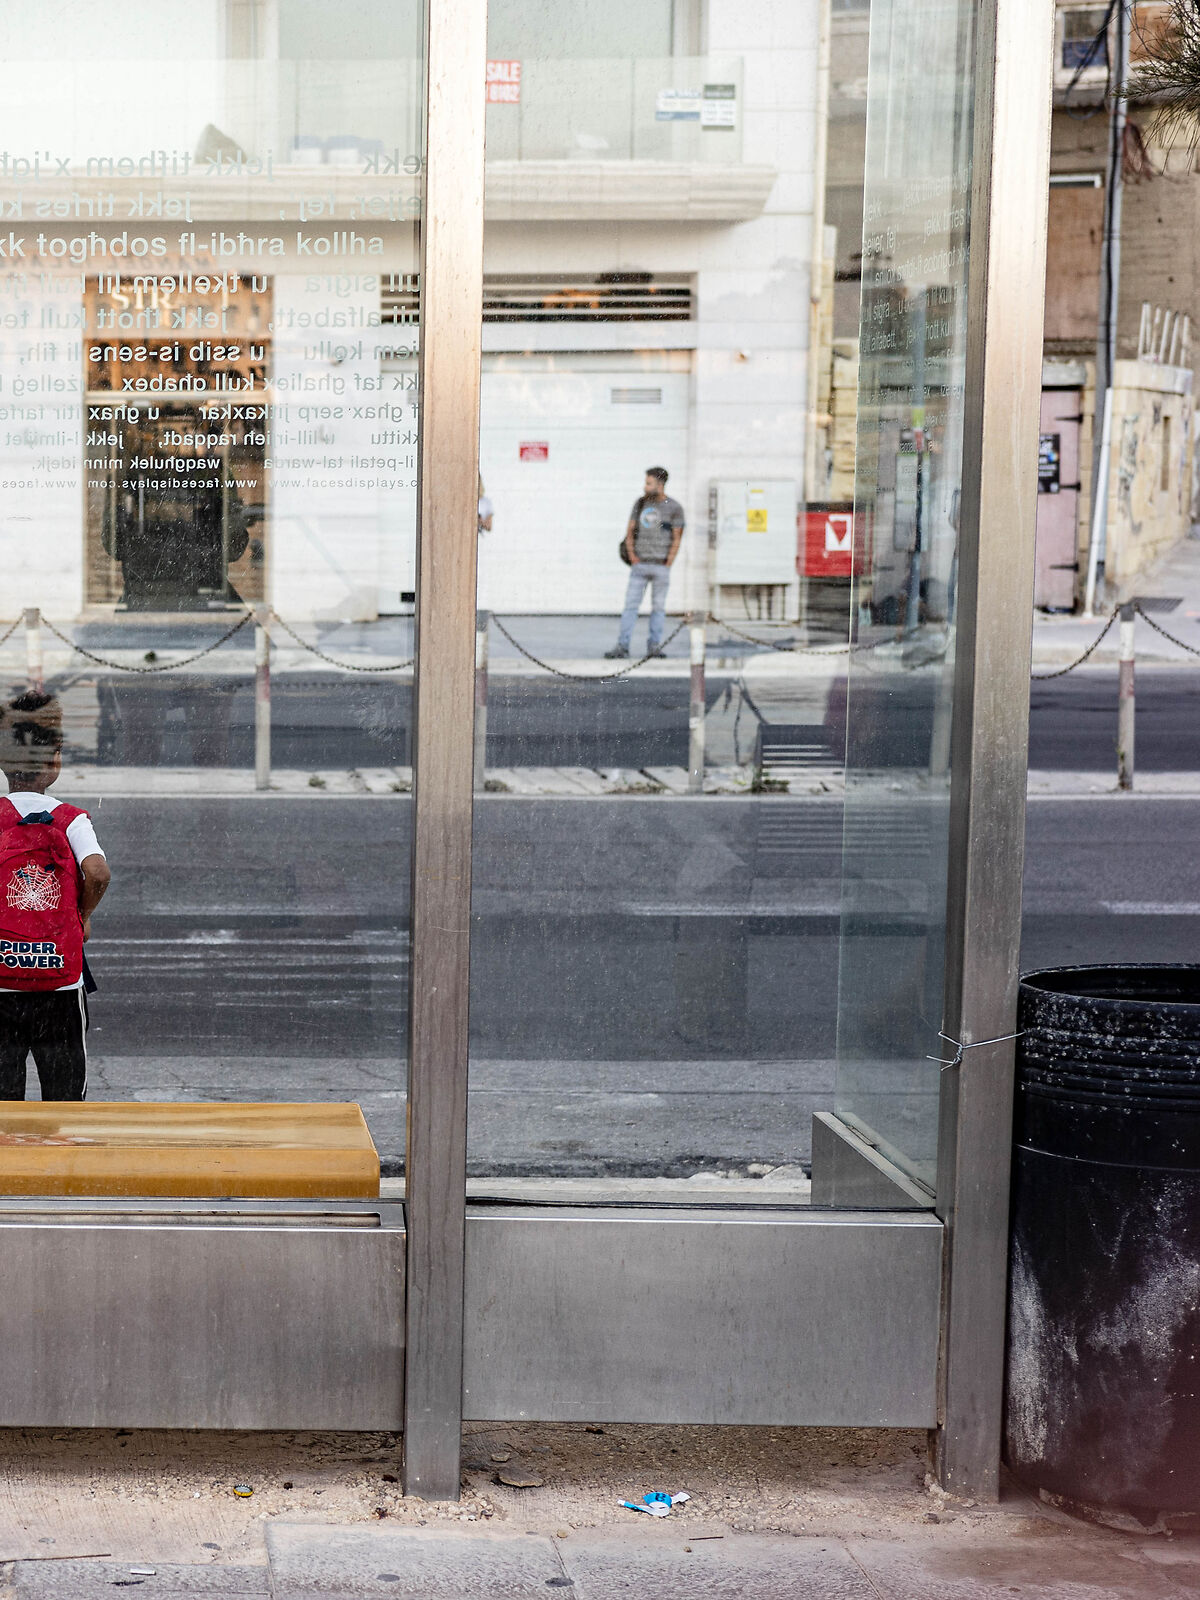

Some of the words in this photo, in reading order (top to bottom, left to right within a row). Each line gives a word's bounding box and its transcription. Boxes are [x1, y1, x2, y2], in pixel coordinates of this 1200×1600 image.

[486, 61, 521, 82] SALE
[36, 231, 168, 264] togħdos
[178, 231, 286, 257] fl-ibħra
[296, 231, 385, 257] kollha
[270, 477, 419, 492] www.facesdisplays.c
